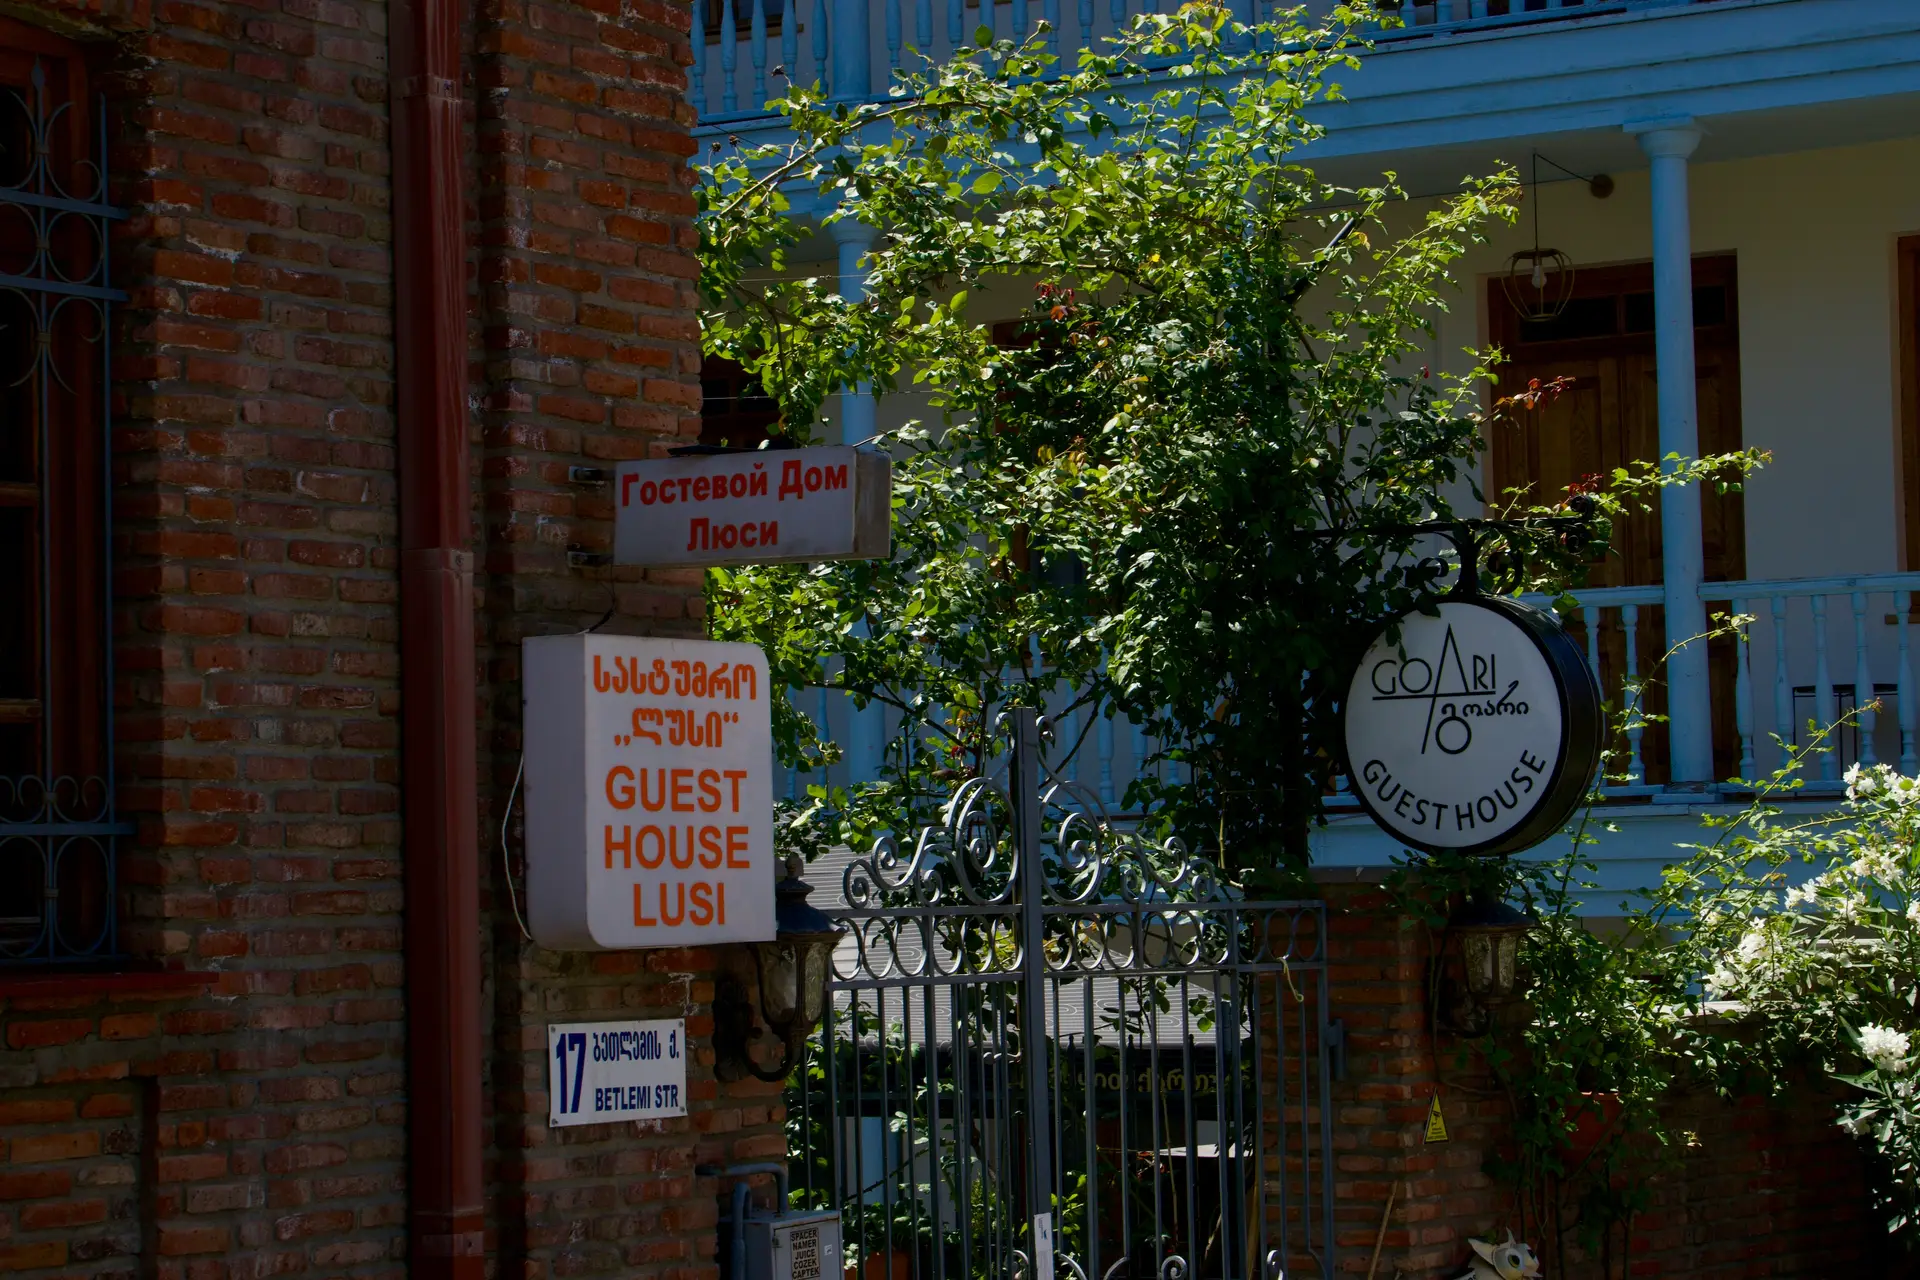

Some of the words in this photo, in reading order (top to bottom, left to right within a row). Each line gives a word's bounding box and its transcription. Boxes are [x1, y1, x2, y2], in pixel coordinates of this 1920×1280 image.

[622, 463, 768, 507] Гостевой
[779, 460, 848, 501] Дом
[687, 517, 779, 551] Люси
[593, 655, 757, 700] სასტუმრო
[605, 765, 747, 812] GUEST
[605, 825, 750, 869] HOUSE
[633, 882, 725, 927] LUSI
[593, 1030, 662, 1062] ბეთლემის
[556, 1032, 587, 1114] 17
[595, 1085, 651, 1112] BETLEMI
[655, 1084, 679, 1109] STR
[790, 1229, 818, 1242] SPACER
[792, 1239, 817, 1251] NAMER
[795, 1248, 817, 1260] JUICE
